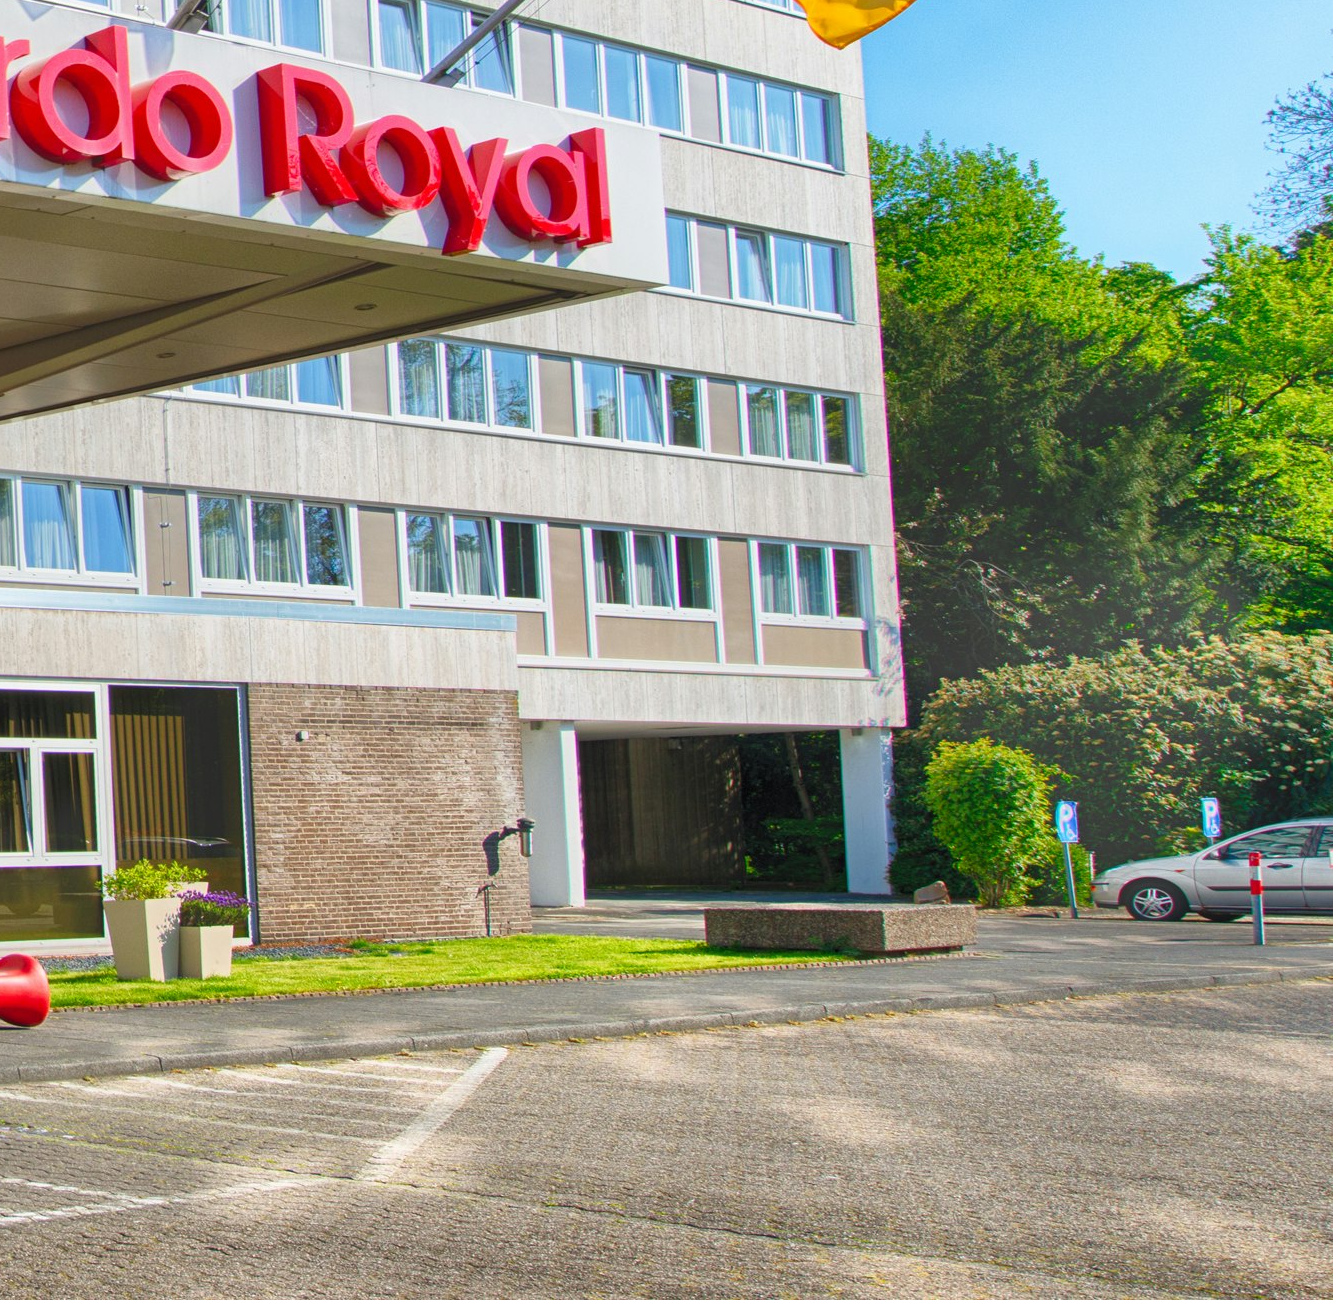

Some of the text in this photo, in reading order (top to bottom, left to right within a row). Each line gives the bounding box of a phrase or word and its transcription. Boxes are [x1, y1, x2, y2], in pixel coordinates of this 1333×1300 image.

[256, 62, 614, 257] Royal
[1060, 803, 1074, 833] P
[1206, 801, 1216, 829] P
